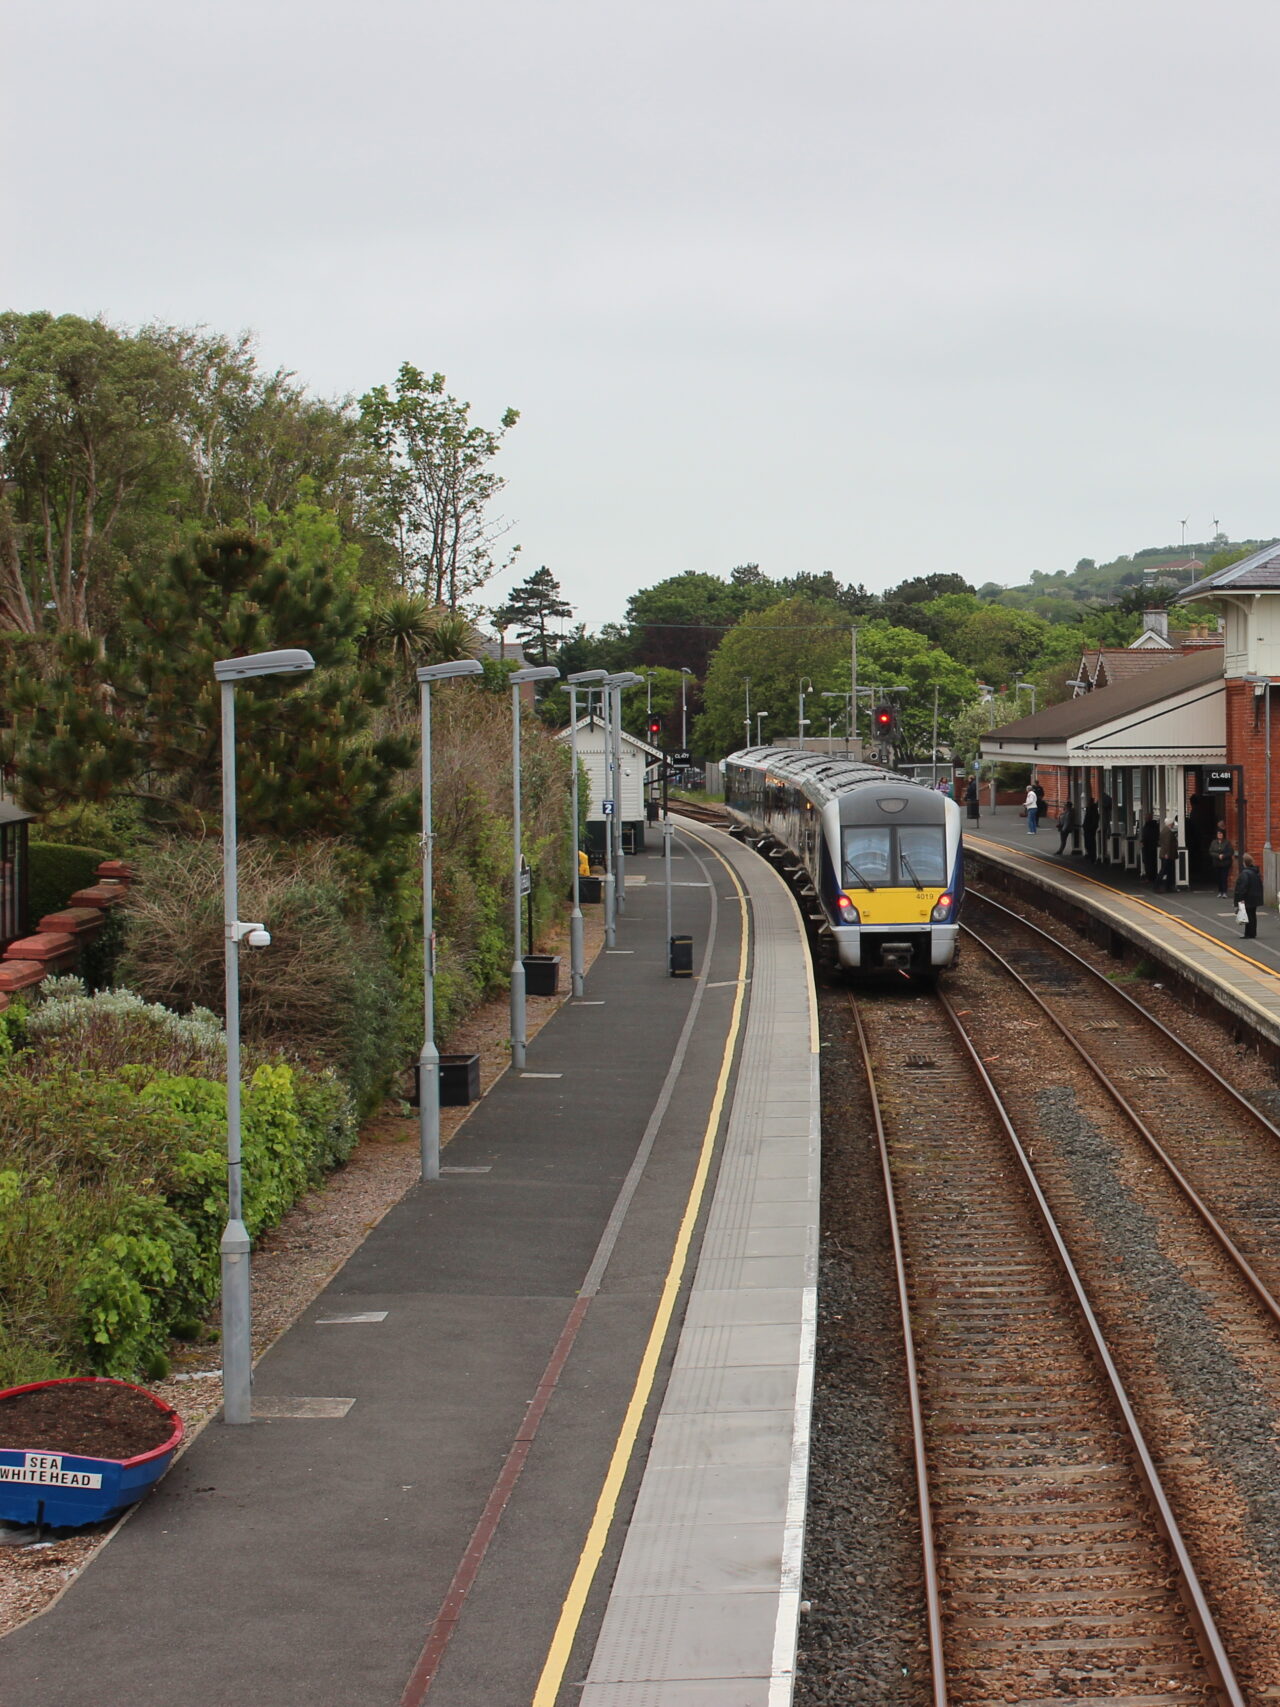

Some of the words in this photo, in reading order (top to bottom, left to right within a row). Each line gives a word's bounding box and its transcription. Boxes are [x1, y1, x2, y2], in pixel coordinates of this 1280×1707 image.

[604, 804, 612, 814] 2
[29, 1456, 59, 1470] SEA
[0, 1467, 91, 1486] WHITEHEAD
